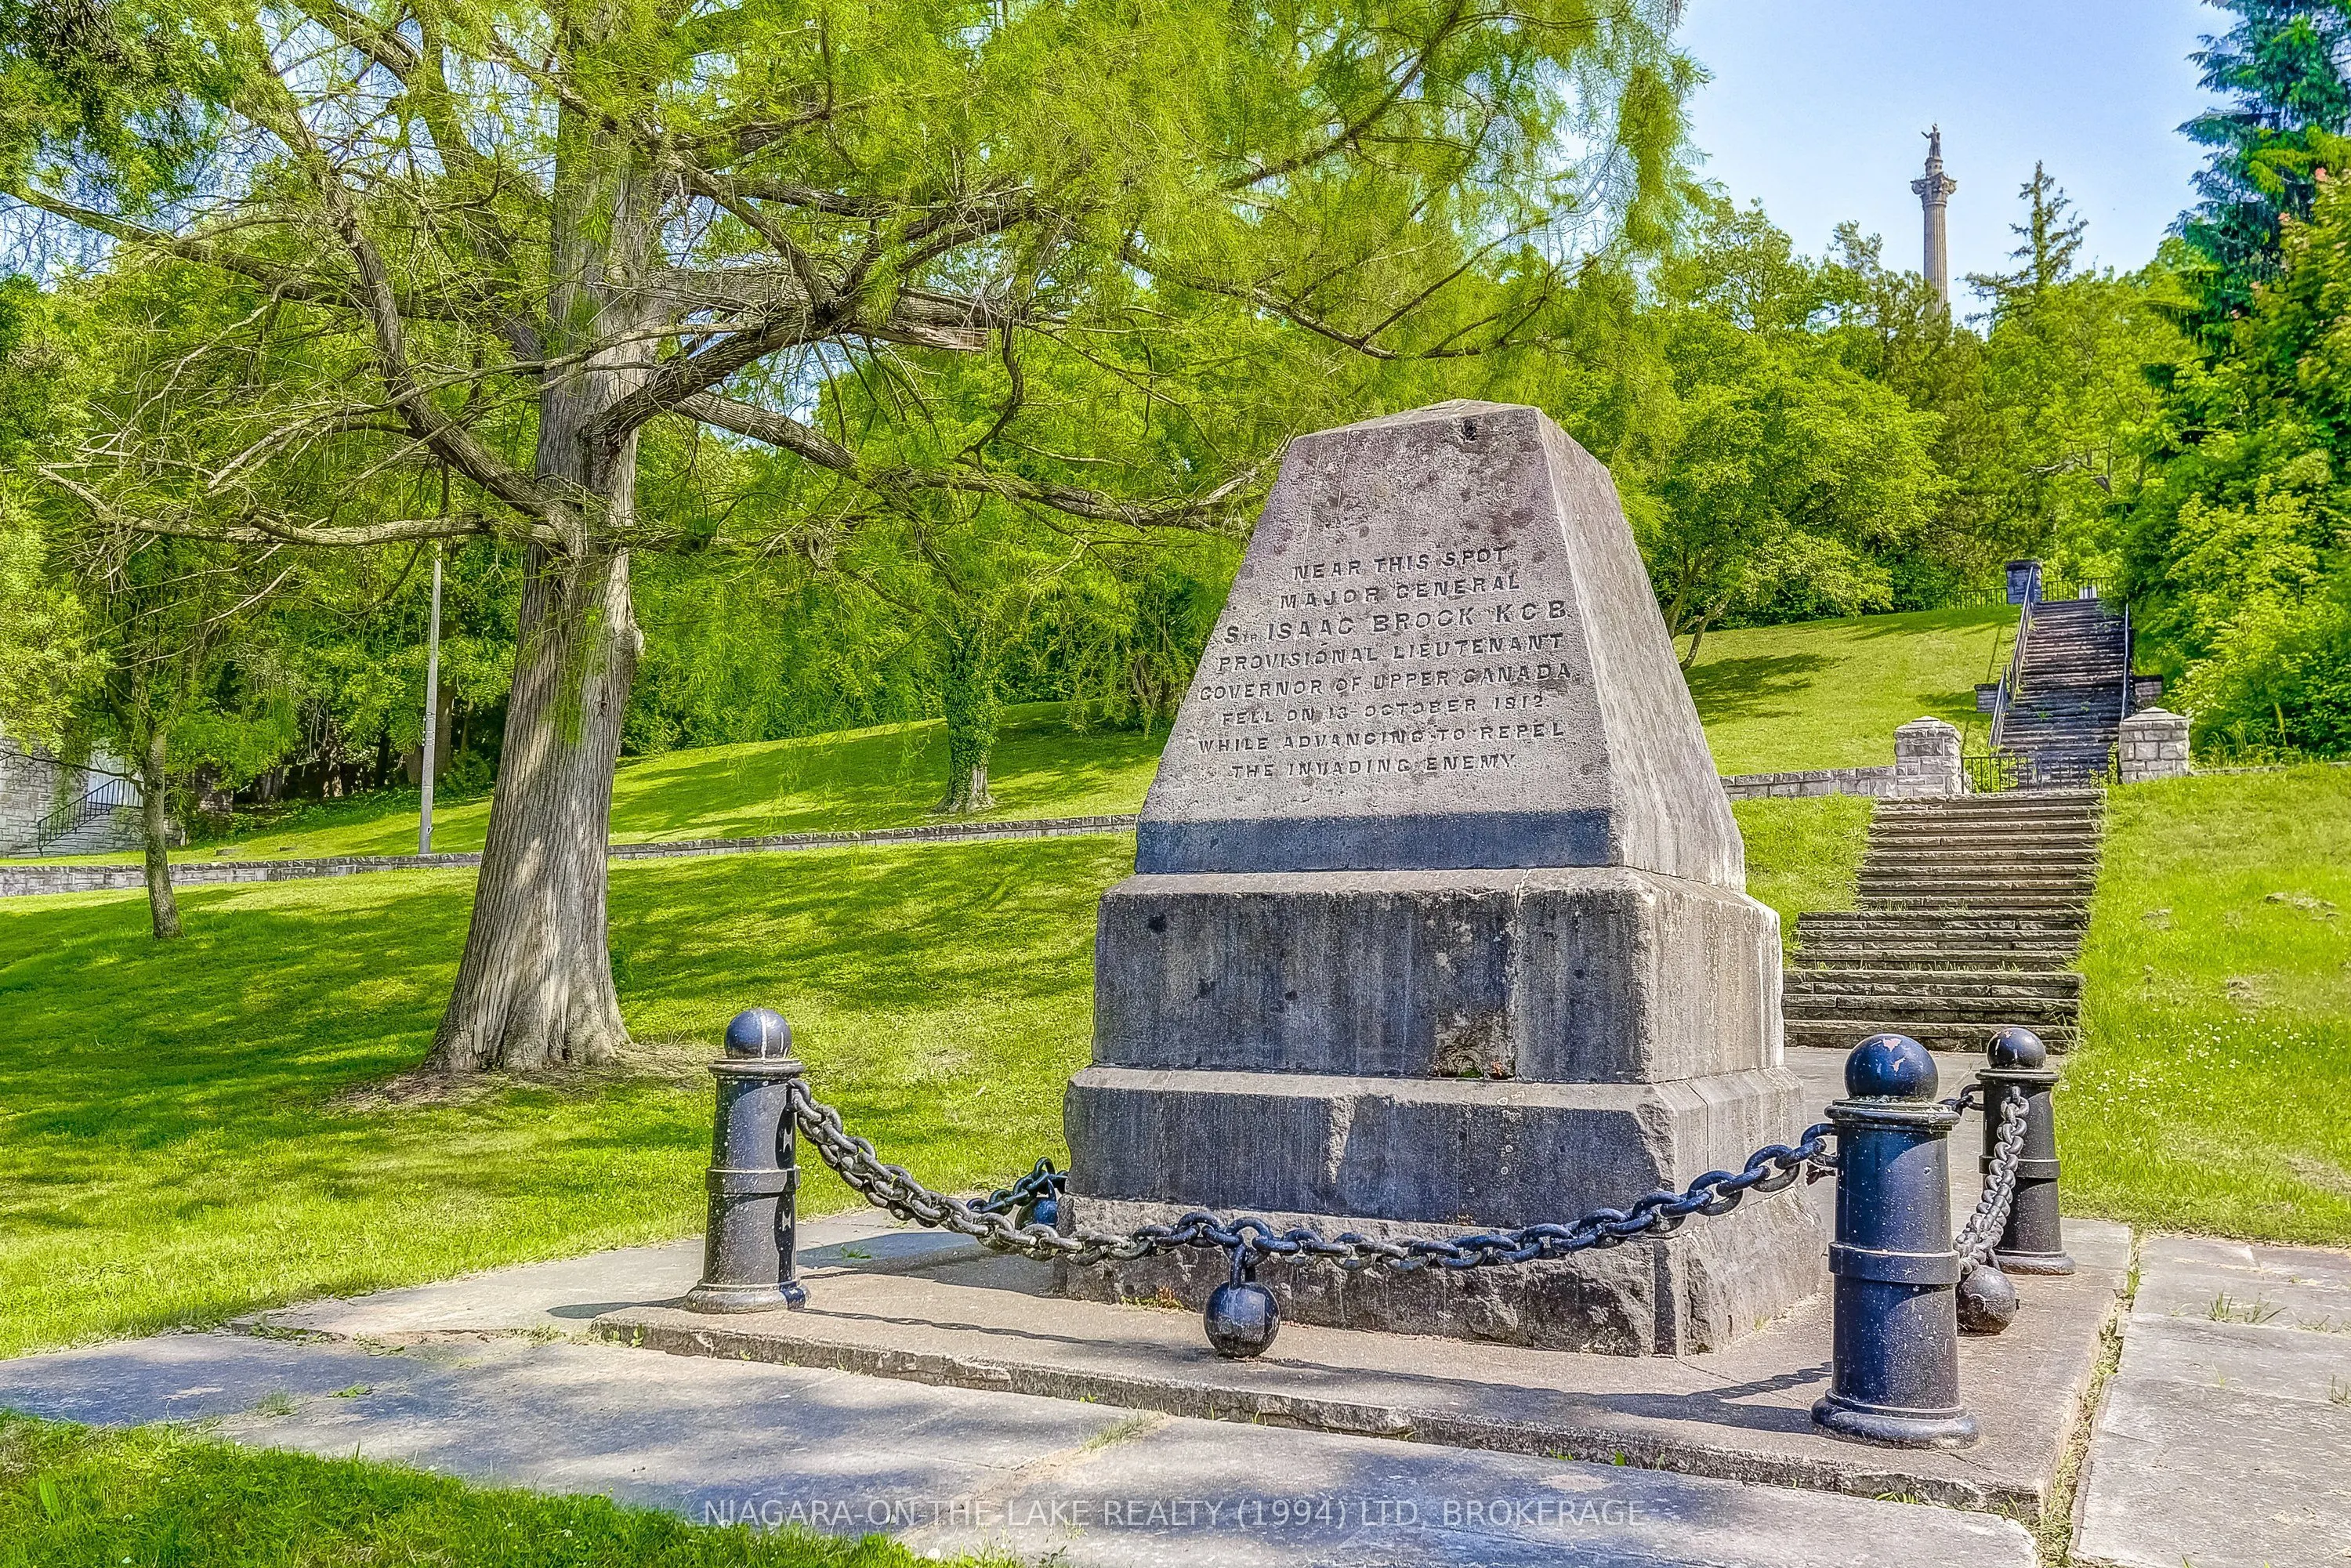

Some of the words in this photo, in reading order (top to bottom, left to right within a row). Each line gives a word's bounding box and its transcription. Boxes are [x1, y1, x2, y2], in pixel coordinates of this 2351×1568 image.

[1293, 559, 1362, 581] NEAR
[1375, 553, 1430, 572] THIS
[1441, 546, 1508, 567] SPOT
[1280, 586, 1380, 610] MAJOR
[1396, 573, 1521, 600] GENERAL
[1267, 615, 1355, 643] ISAAC
[1372, 607, 1475, 633] BROCK
[1218, 648, 1378, 672] PROVISIONAL
[1393, 632, 1563, 660] LIEUTENANT
[1199, 679, 1324, 701] GOVERNOR
[1335, 675, 1362, 693] OF
[1373, 669, 1450, 690] UPPER
[1463, 662, 1571, 685] CANADA
[1223, 709, 1275, 726] FELL
[1287, 707, 1316, 722] ON
[1198, 735, 1269, 754] WHILE
[1283, 729, 1423, 749] ADVANCING
[1436, 728, 1465, 742] TO
[1480, 722, 1565, 741] REPEL
[1231, 764, 1275, 778] THE
[1288, 758, 1411, 775] INVADING
